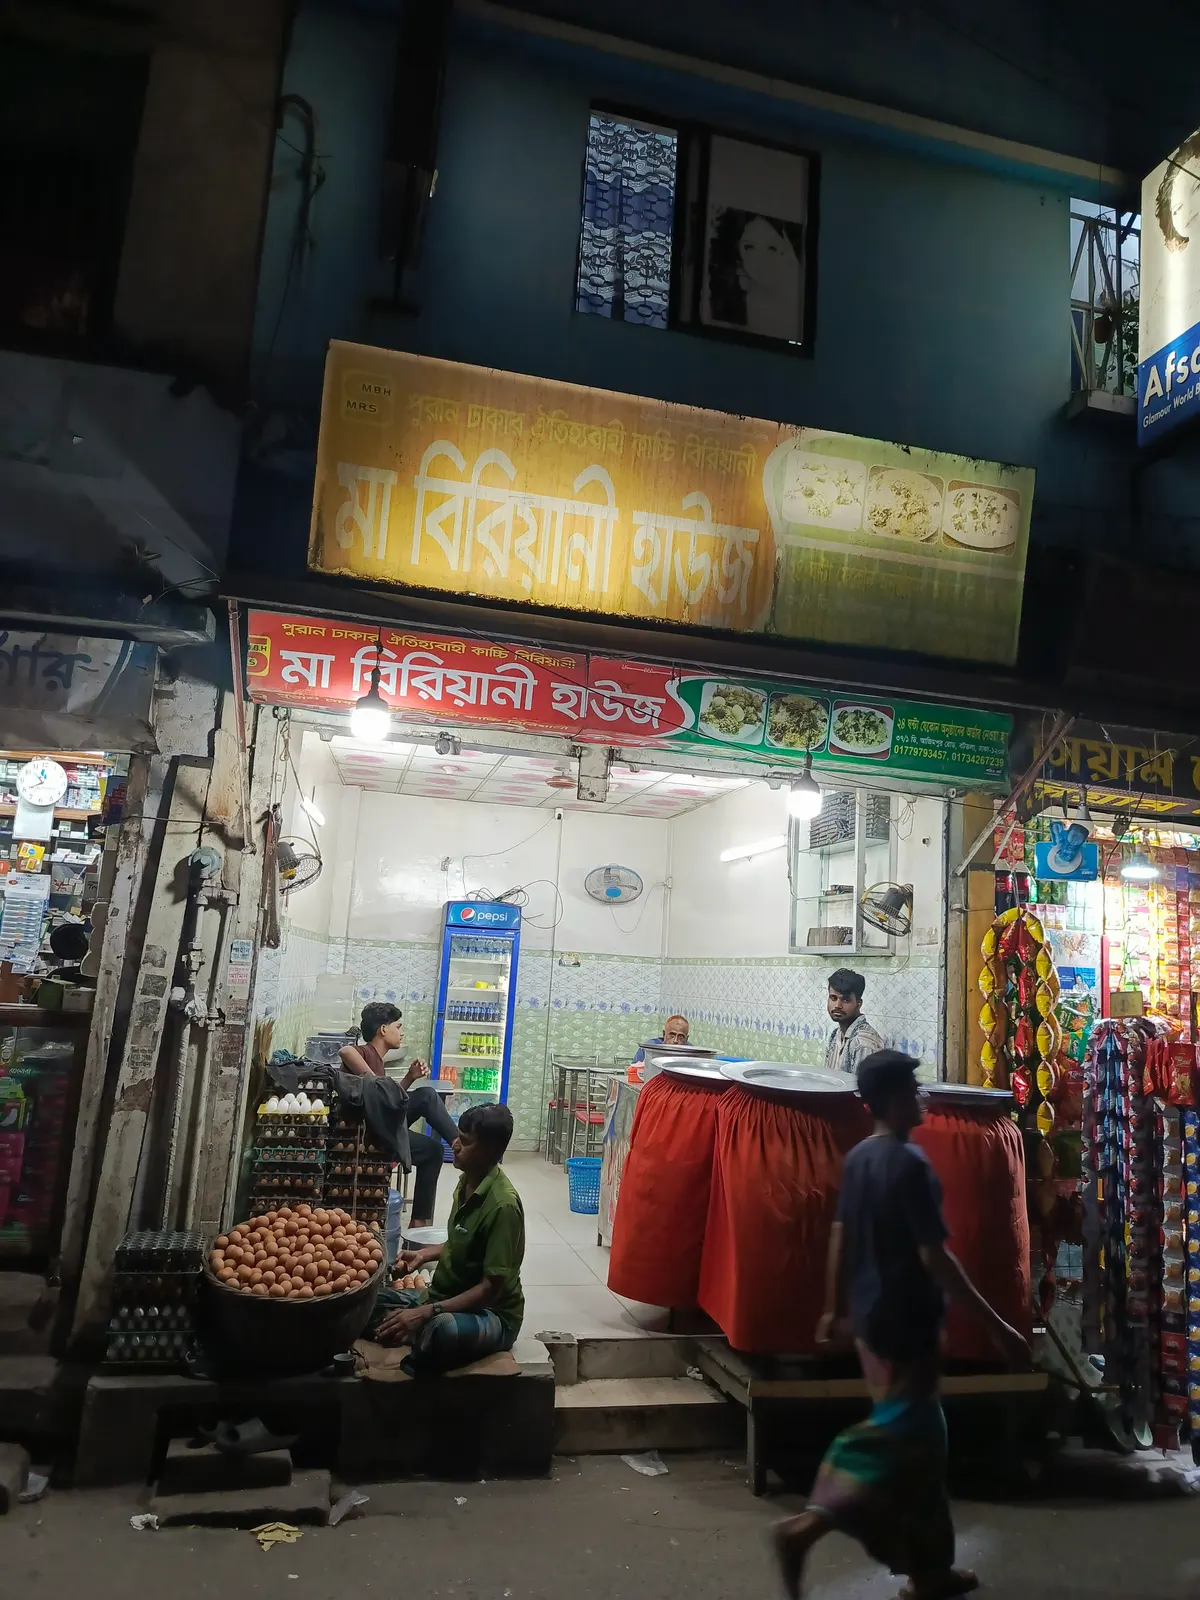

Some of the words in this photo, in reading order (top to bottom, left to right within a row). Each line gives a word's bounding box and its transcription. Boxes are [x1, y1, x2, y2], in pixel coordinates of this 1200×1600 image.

[1143, 404, 1172, 428] Glamour
[1173, 385, 1195, 409] World
[336, 462, 397, 561] মা
[413, 438, 620, 595] বিরিয়ানী
[631, 491, 760, 614] হাউজ
[282, 622, 327, 638] পুরান
[332, 627, 381, 644] ঢাকার
[386, 633, 467, 655] ঐতিহ্যবাহী
[471, 645, 510, 661] কাচ্চি
[280, 649, 336, 689] মা
[350, 644, 539, 711] বিরিয়ানী
[551, 680, 666, 731] হাউজ
[951, 752, 1005, 767] 01734267239
[477, 911, 508, 923] pepsi
